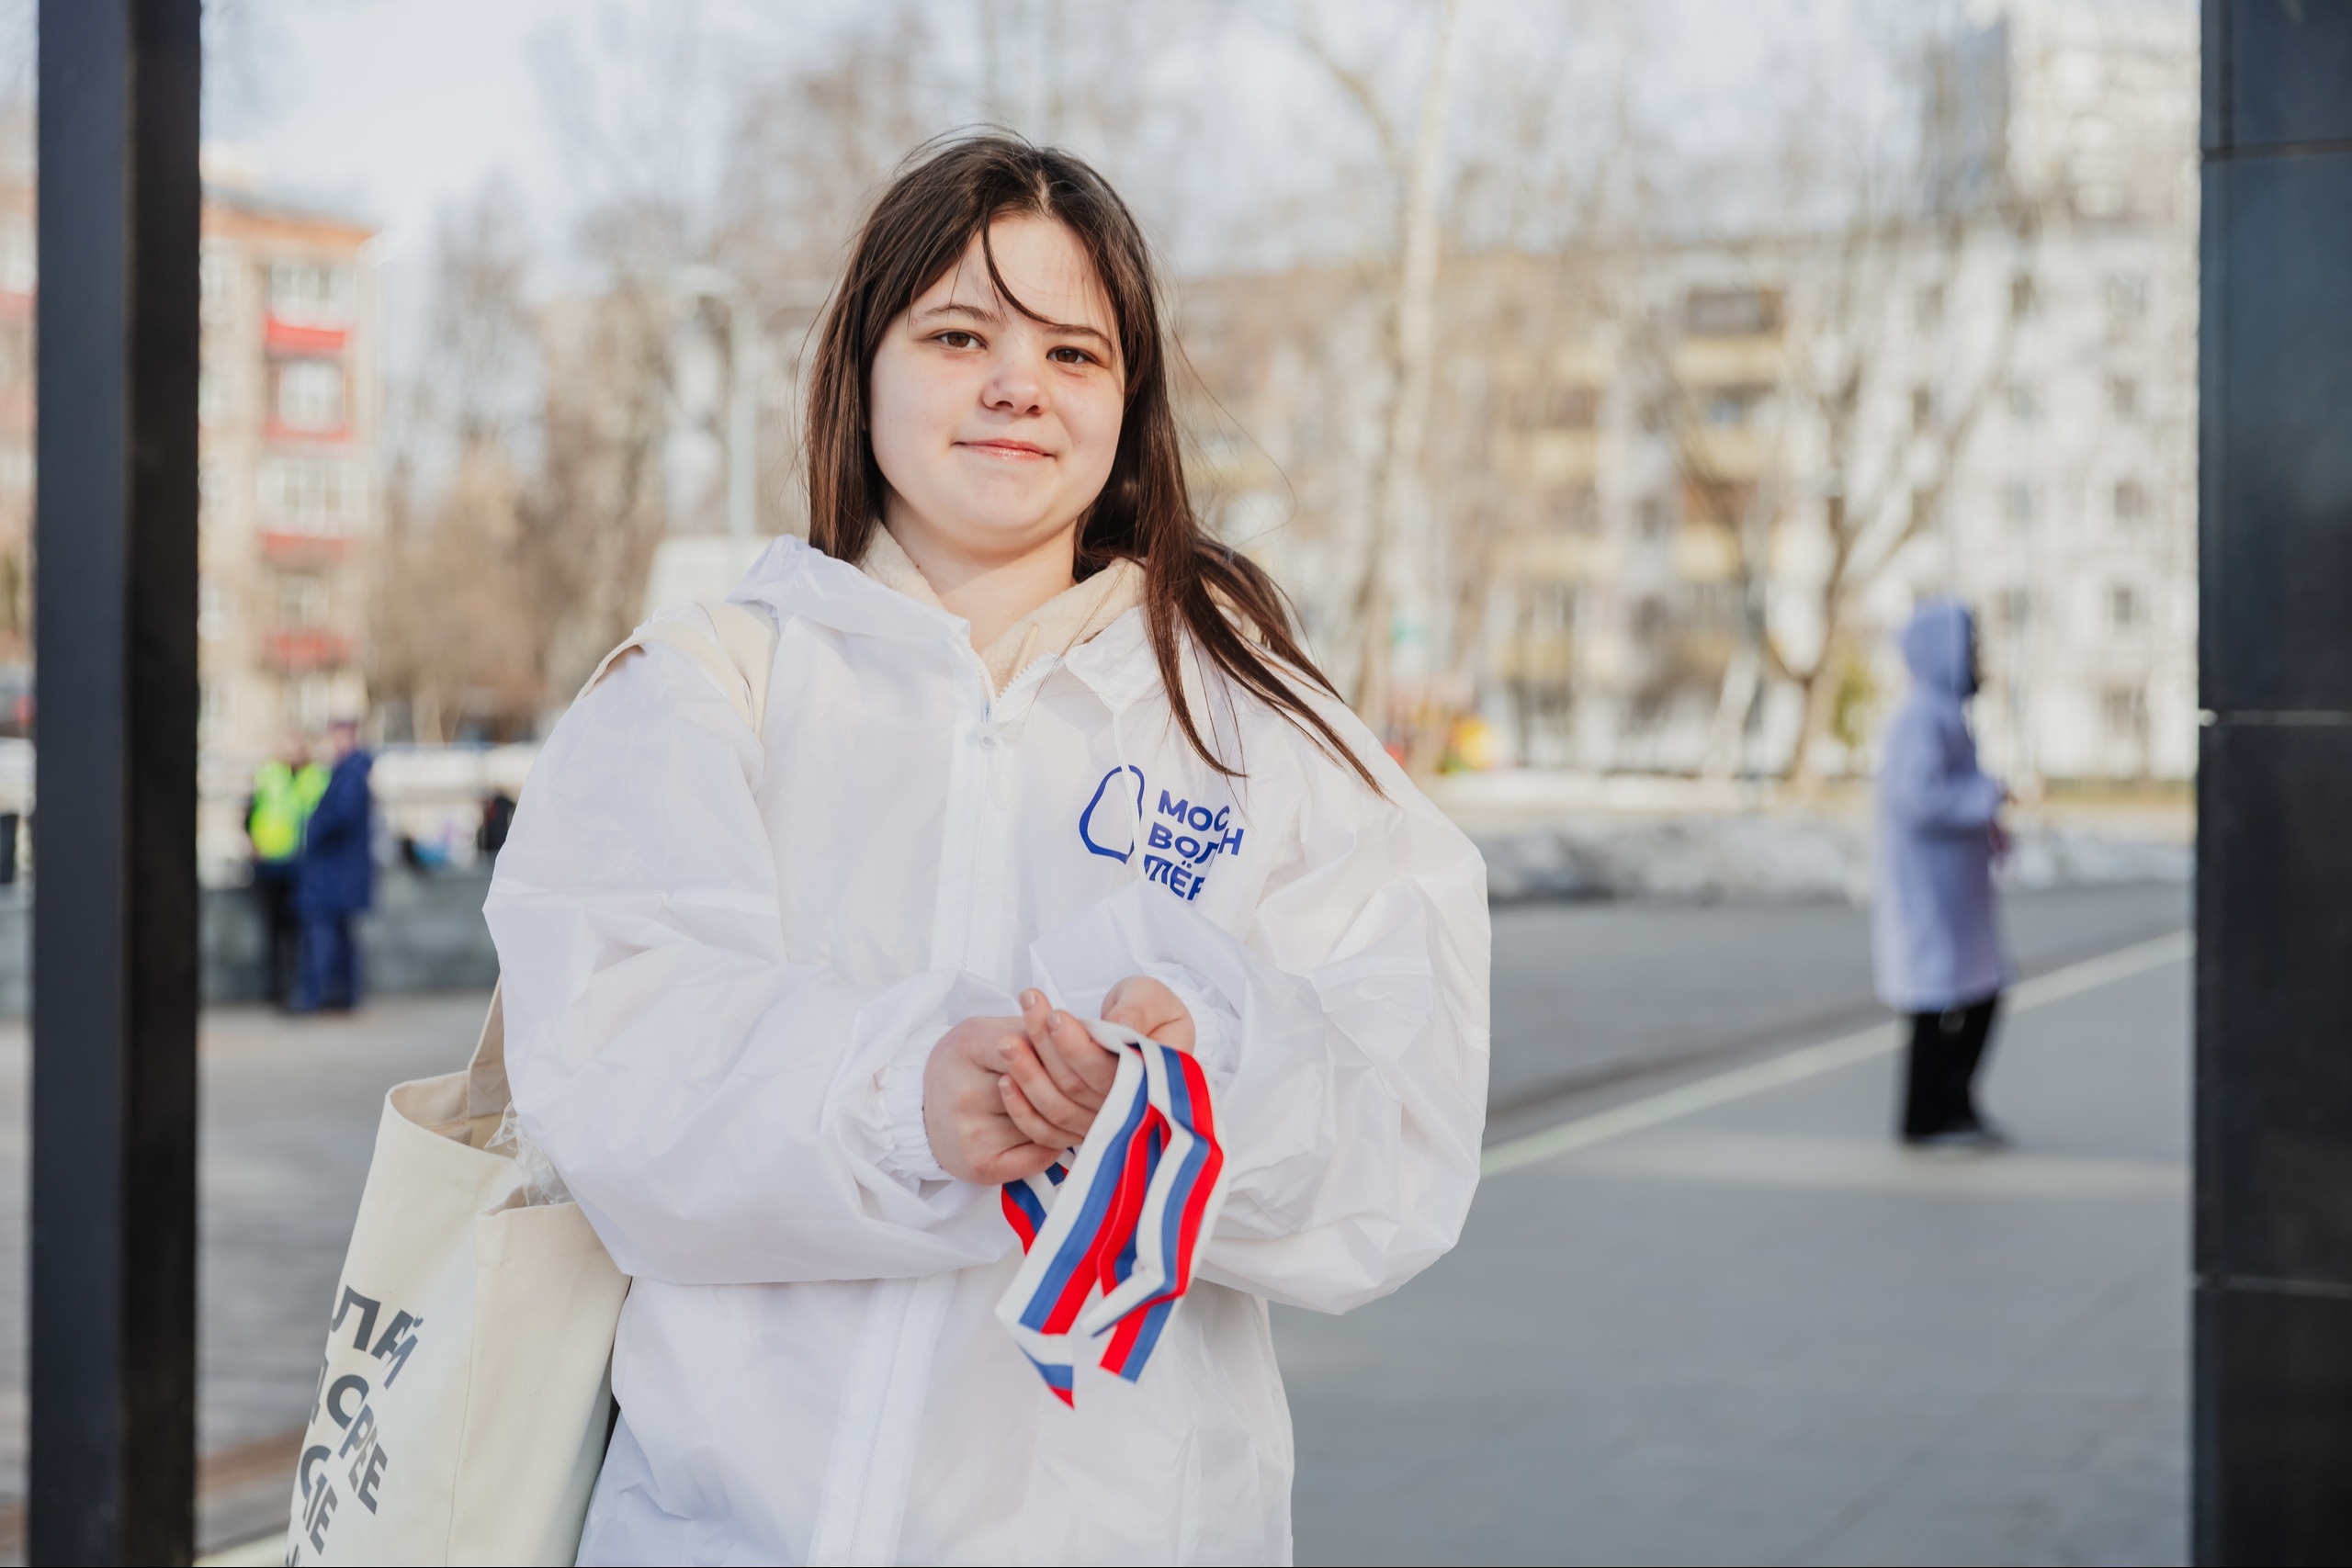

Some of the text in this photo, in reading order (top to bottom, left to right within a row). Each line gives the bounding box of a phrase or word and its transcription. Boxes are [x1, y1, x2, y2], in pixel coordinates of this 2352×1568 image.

[1158, 789, 1230, 831] МОС
[1148, 821, 1244, 864] ВОЛН
[330, 1284, 424, 1390] ЛАЙ
